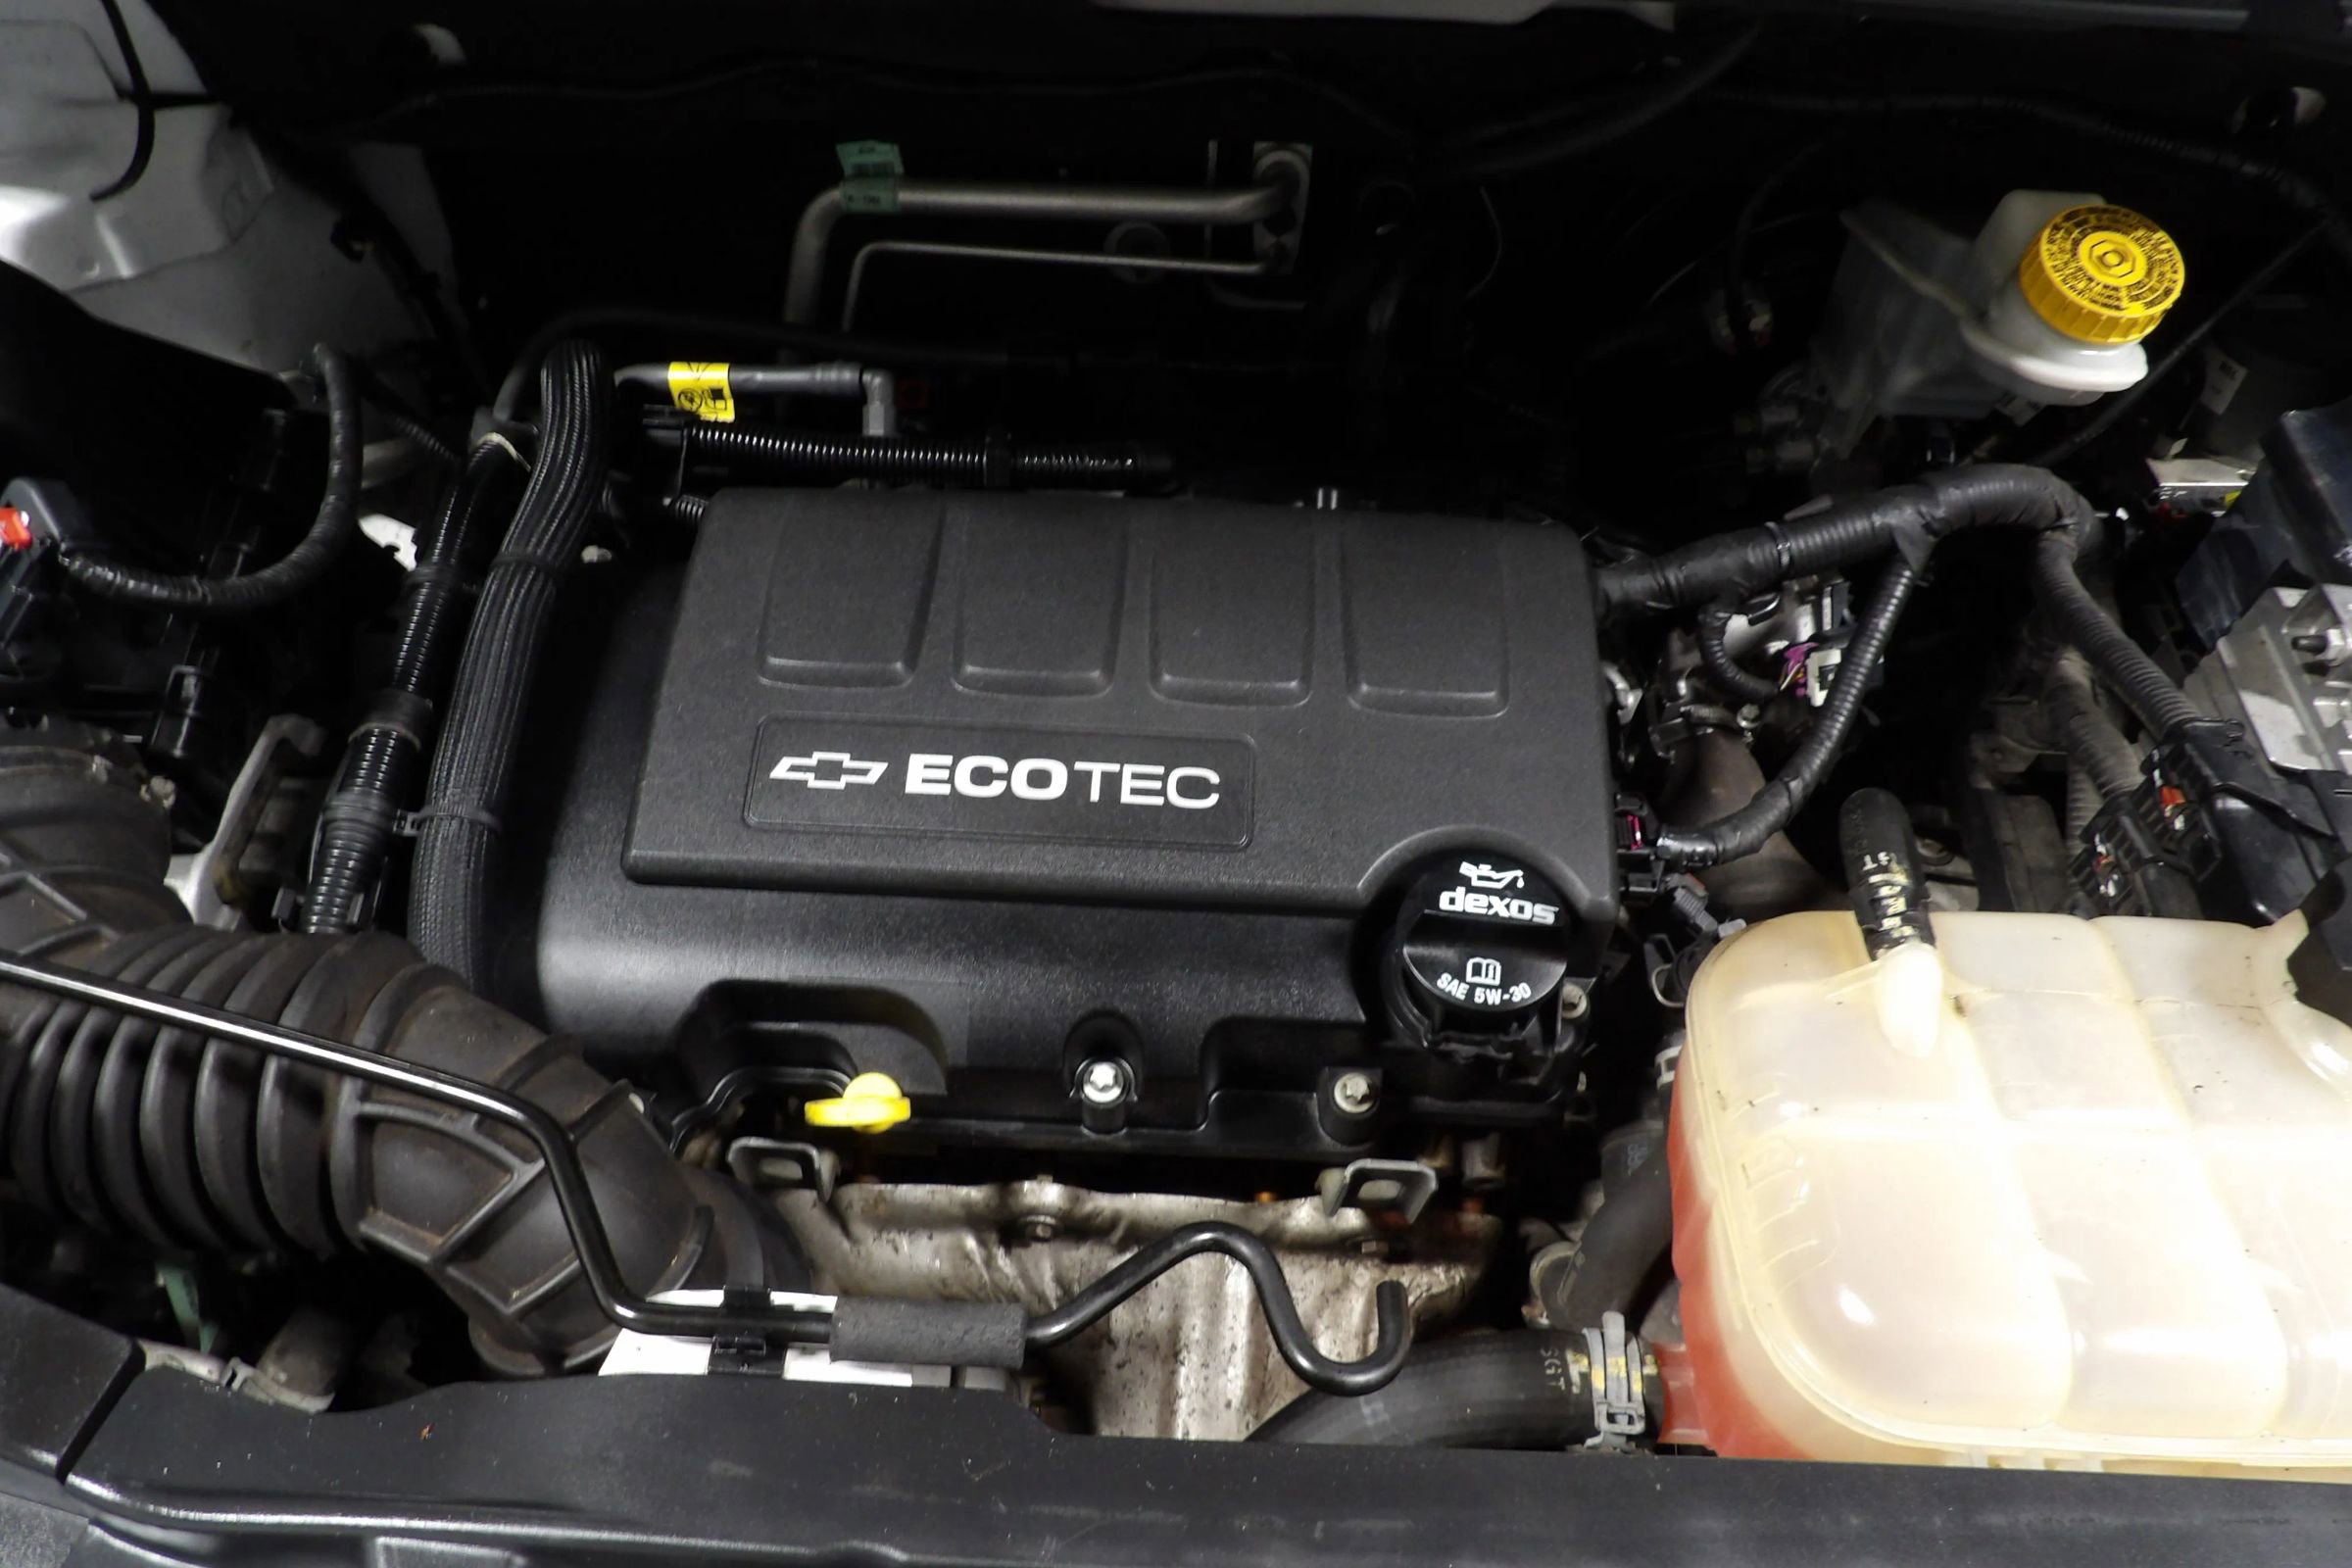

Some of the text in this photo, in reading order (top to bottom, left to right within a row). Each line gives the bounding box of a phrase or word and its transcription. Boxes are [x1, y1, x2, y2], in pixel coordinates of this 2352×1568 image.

[905, 754, 1221, 809] ECOTEC
[1439, 886, 1560, 926] dexos
[1436, 972, 1532, 1005] SAE 5W-30
